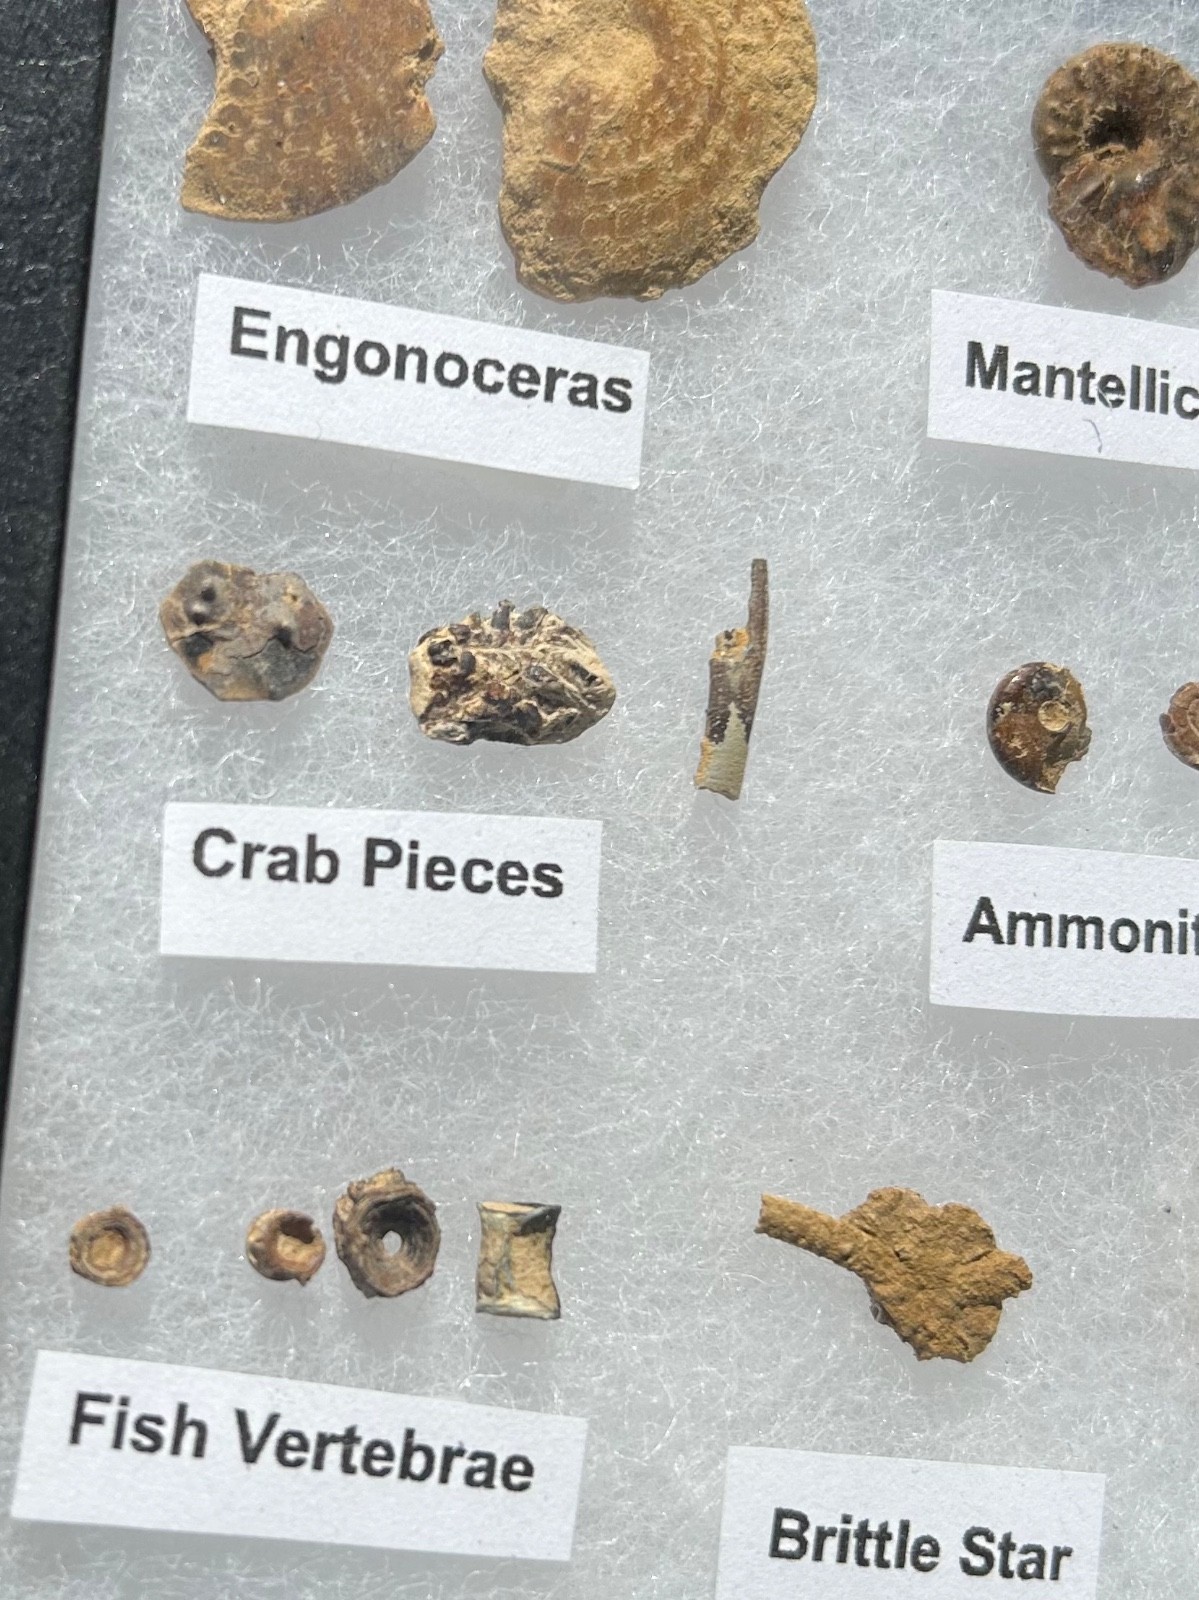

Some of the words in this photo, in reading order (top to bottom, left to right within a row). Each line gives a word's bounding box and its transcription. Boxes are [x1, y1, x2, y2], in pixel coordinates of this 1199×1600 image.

[229, 306, 633, 414] Engonoceras
[192, 828, 340, 884] Crab
[363, 837, 565, 899] Pieces
[69, 1392, 208, 1458] Fish
[235, 1409, 535, 1493] Vertebrae
[769, 1507, 942, 1574] Brittle
[959, 1526, 1074, 1582] Star
